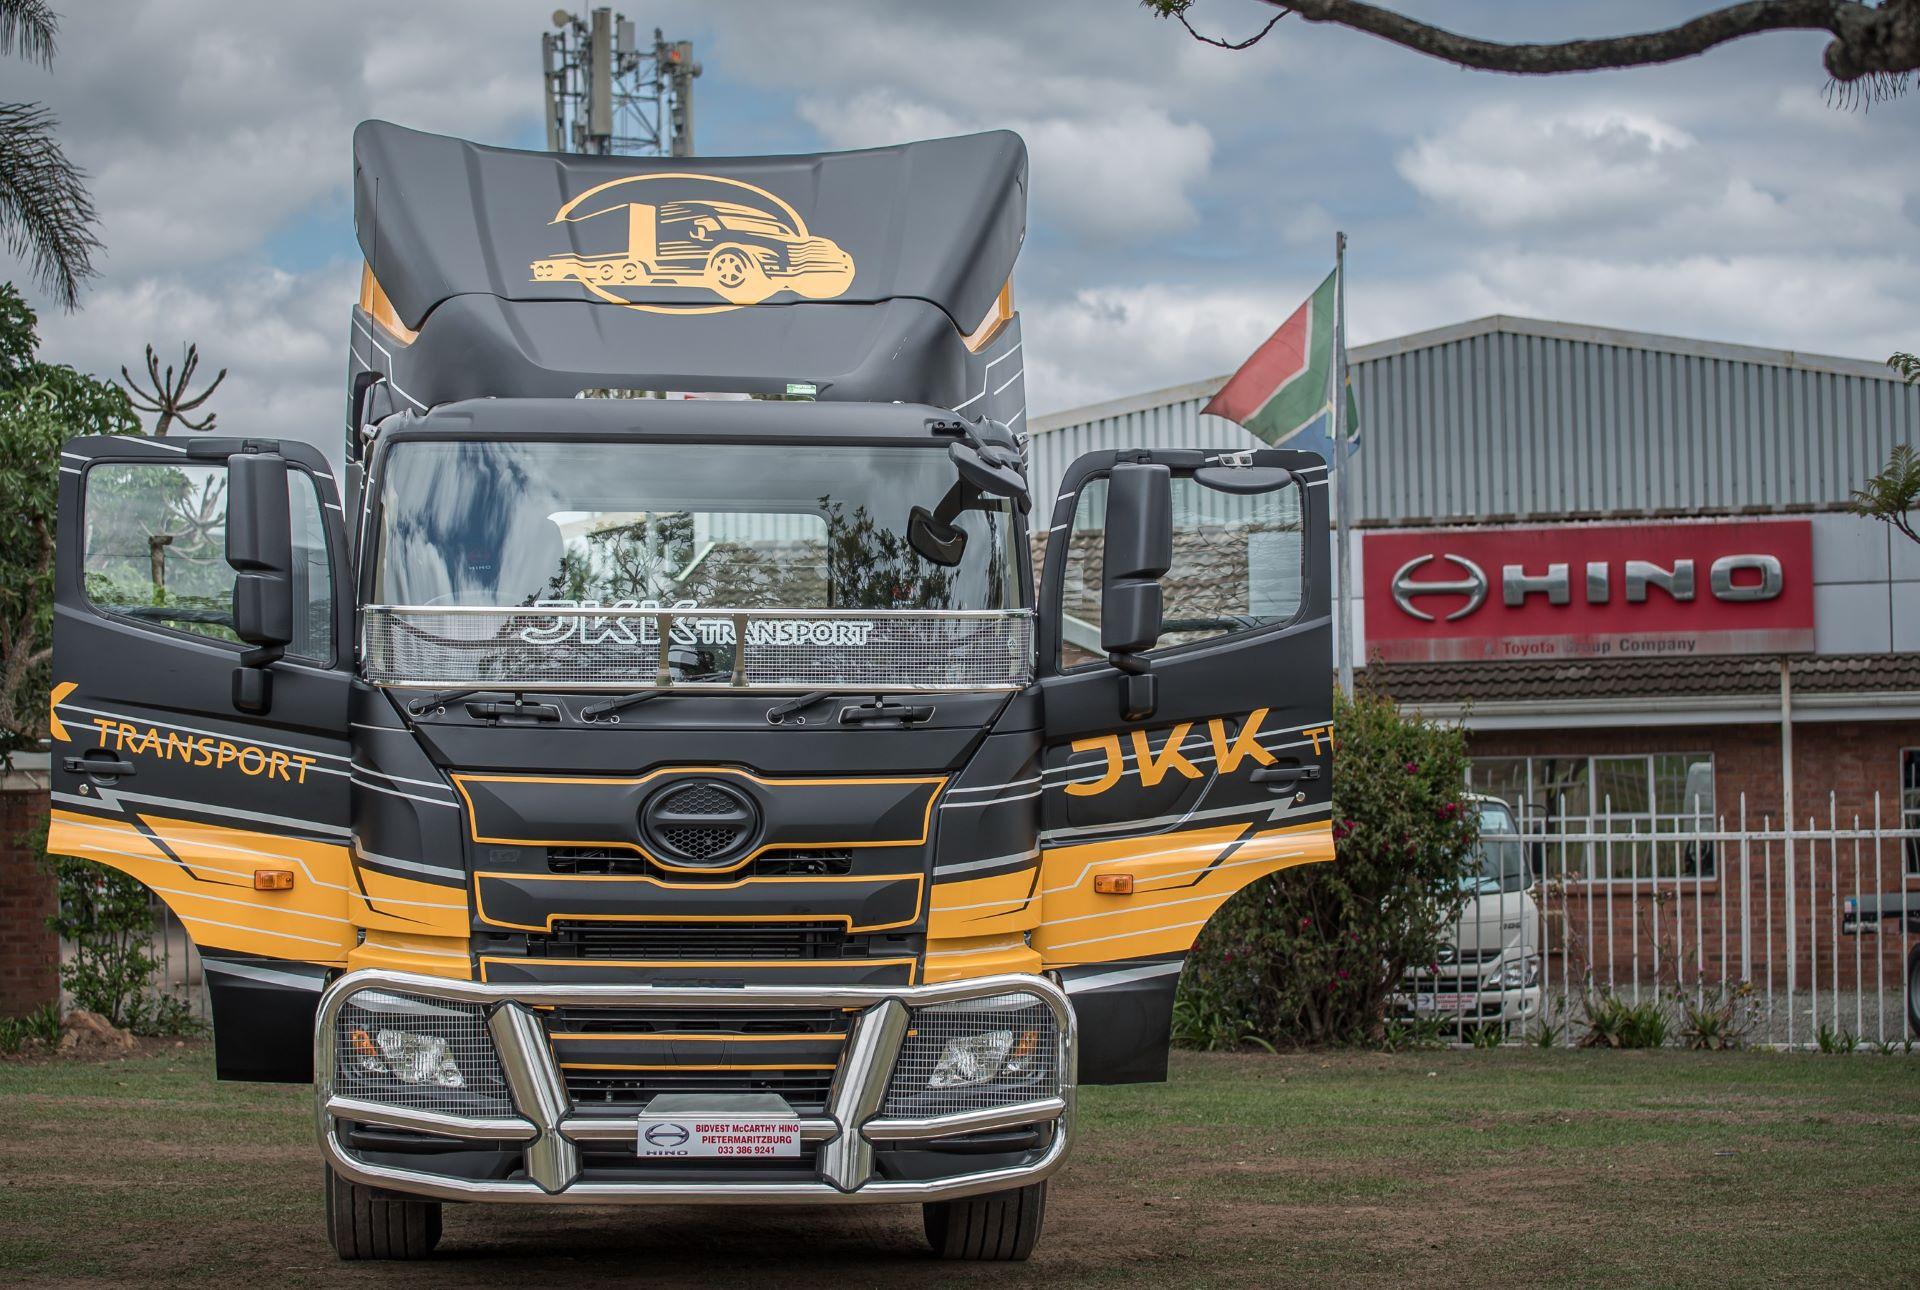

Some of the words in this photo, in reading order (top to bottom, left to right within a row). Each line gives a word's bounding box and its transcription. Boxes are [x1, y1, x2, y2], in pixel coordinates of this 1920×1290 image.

[1502, 553, 1783, 606] HINO
[1503, 640, 1555, 656] Toyota
[1619, 637, 1696, 653] Company
[93, 718, 317, 784] TRANSPORT
[1063, 707, 1279, 796] JKK
[695, 1124, 730, 1133] BIDVEST
[732, 1124, 776, 1133] McCARTHY
[778, 1124, 799, 1133] HINO
[701, 1135, 792, 1144] PIETERMARITZBURG
[717, 1146, 734, 1155] 033
[736, 1146, 752, 1155] 386
[754, 1146, 775, 1155] 9241
